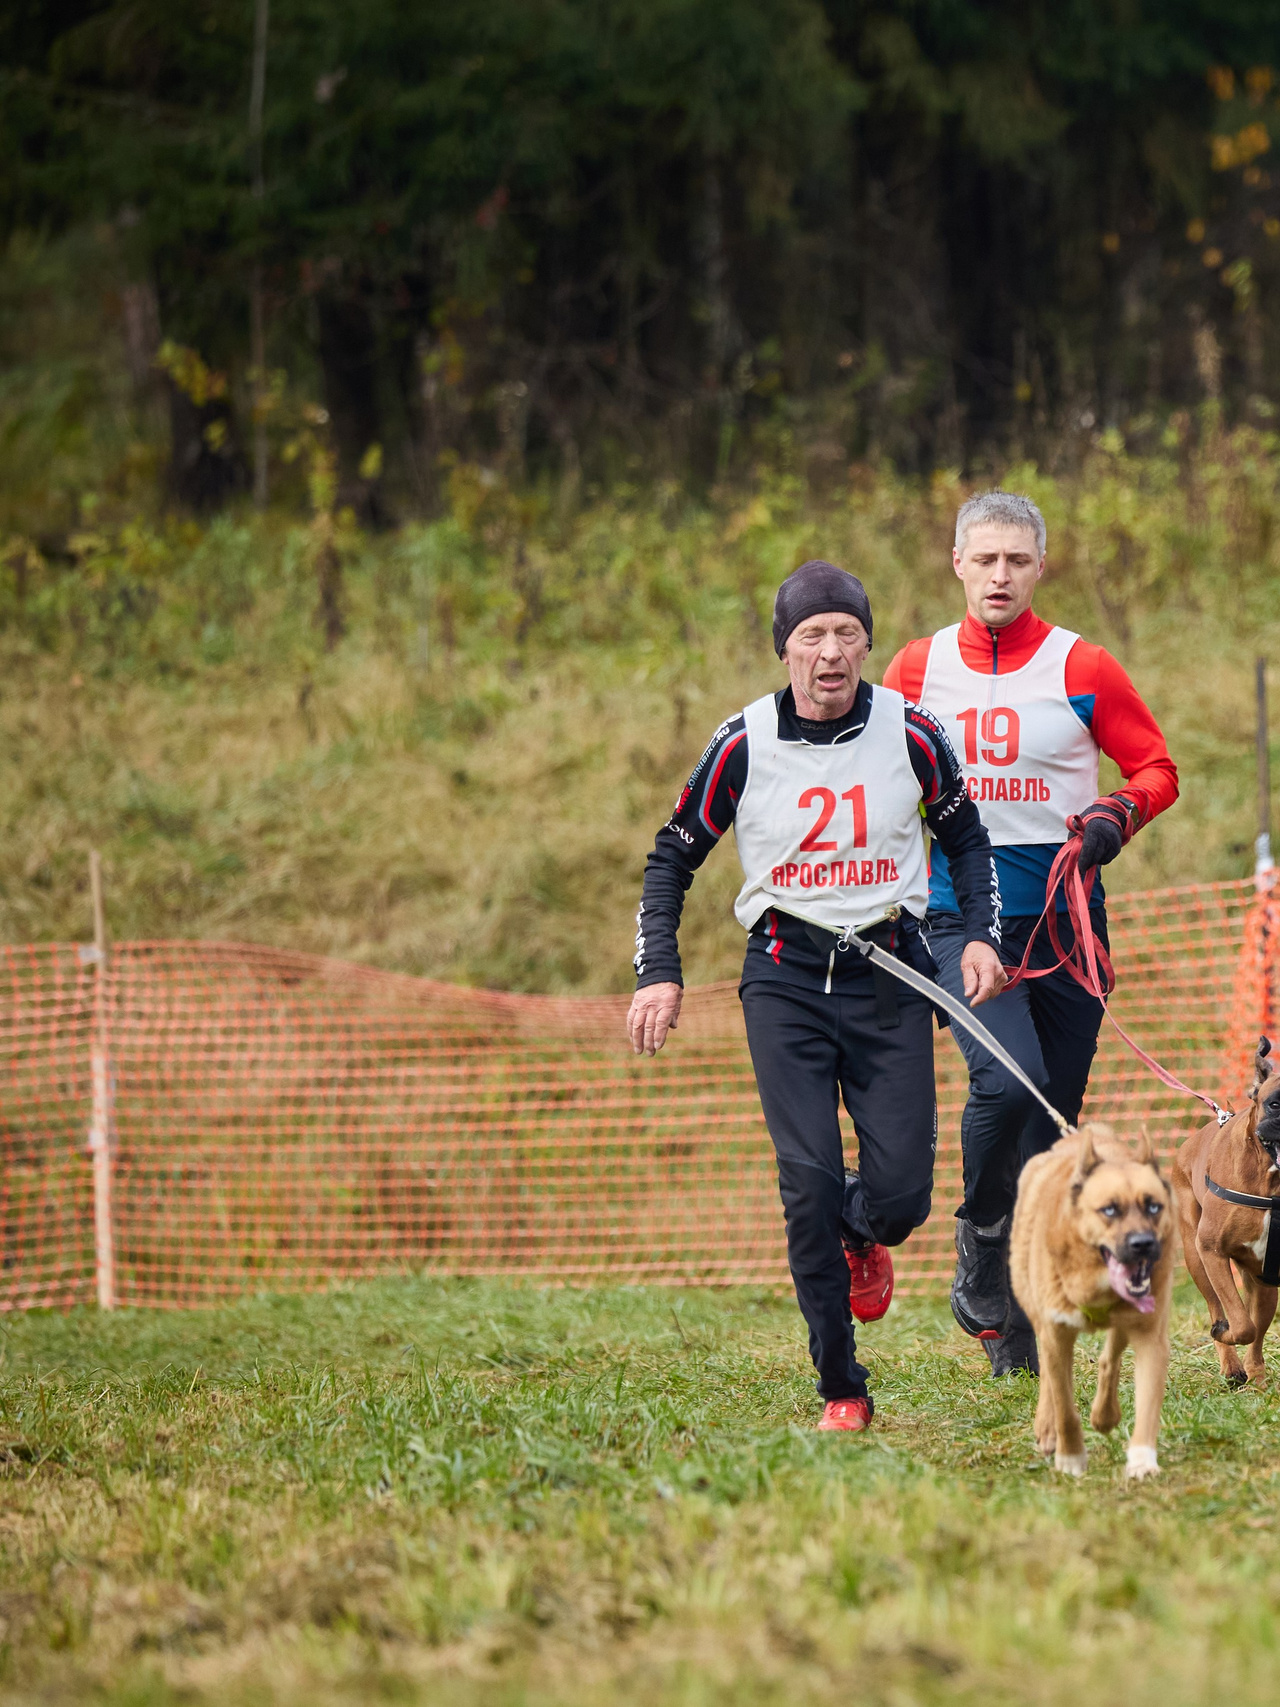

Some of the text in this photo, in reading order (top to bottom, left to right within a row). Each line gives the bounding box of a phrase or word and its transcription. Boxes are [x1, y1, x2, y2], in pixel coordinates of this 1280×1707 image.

[956, 707, 1020, 767] 19
[964, 776, 1051, 802] СЛАВЛЬ
[798, 784, 867, 852] 21
[771, 857, 900, 889] ЯРОСЛАВЛЬ
